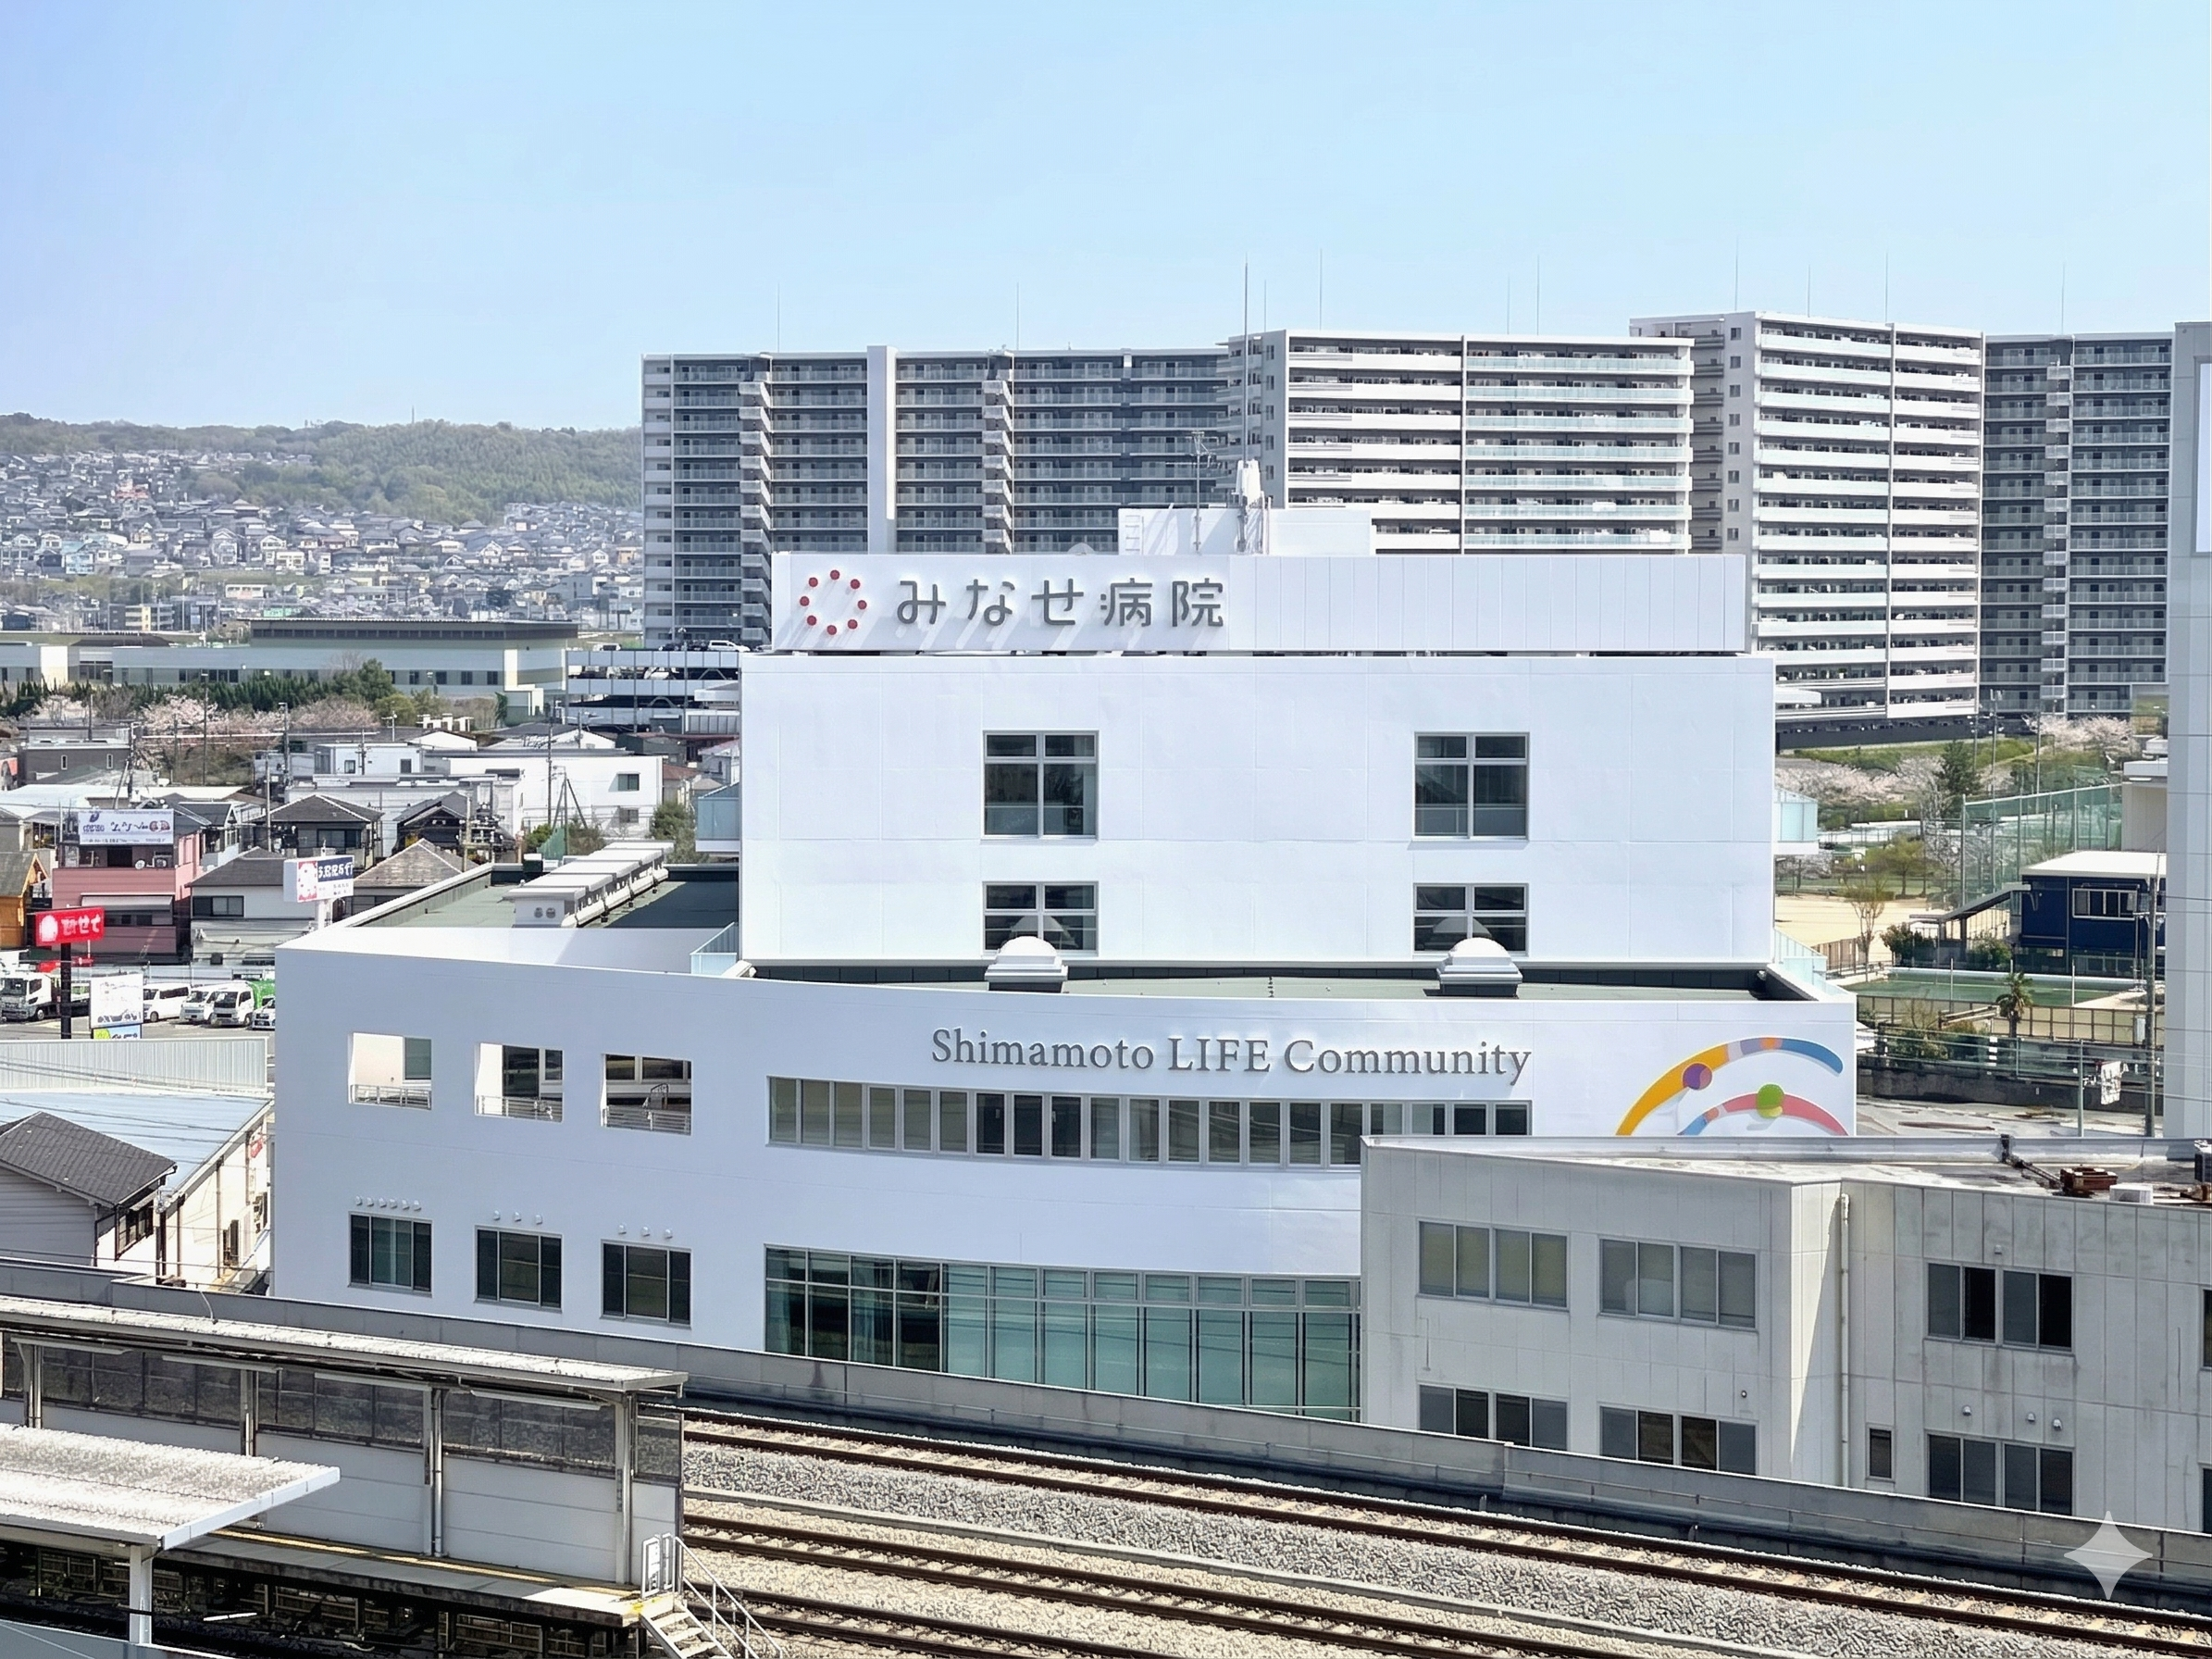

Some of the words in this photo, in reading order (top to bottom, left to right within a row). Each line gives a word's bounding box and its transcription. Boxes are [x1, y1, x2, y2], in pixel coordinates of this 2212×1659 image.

[895, 577, 1224, 629] みなせ病院
[931, 1029, 1155, 1071] Shimamoto
[1167, 1037, 1272, 1073] LIFE
[1284, 1039, 1533, 1088] Community
